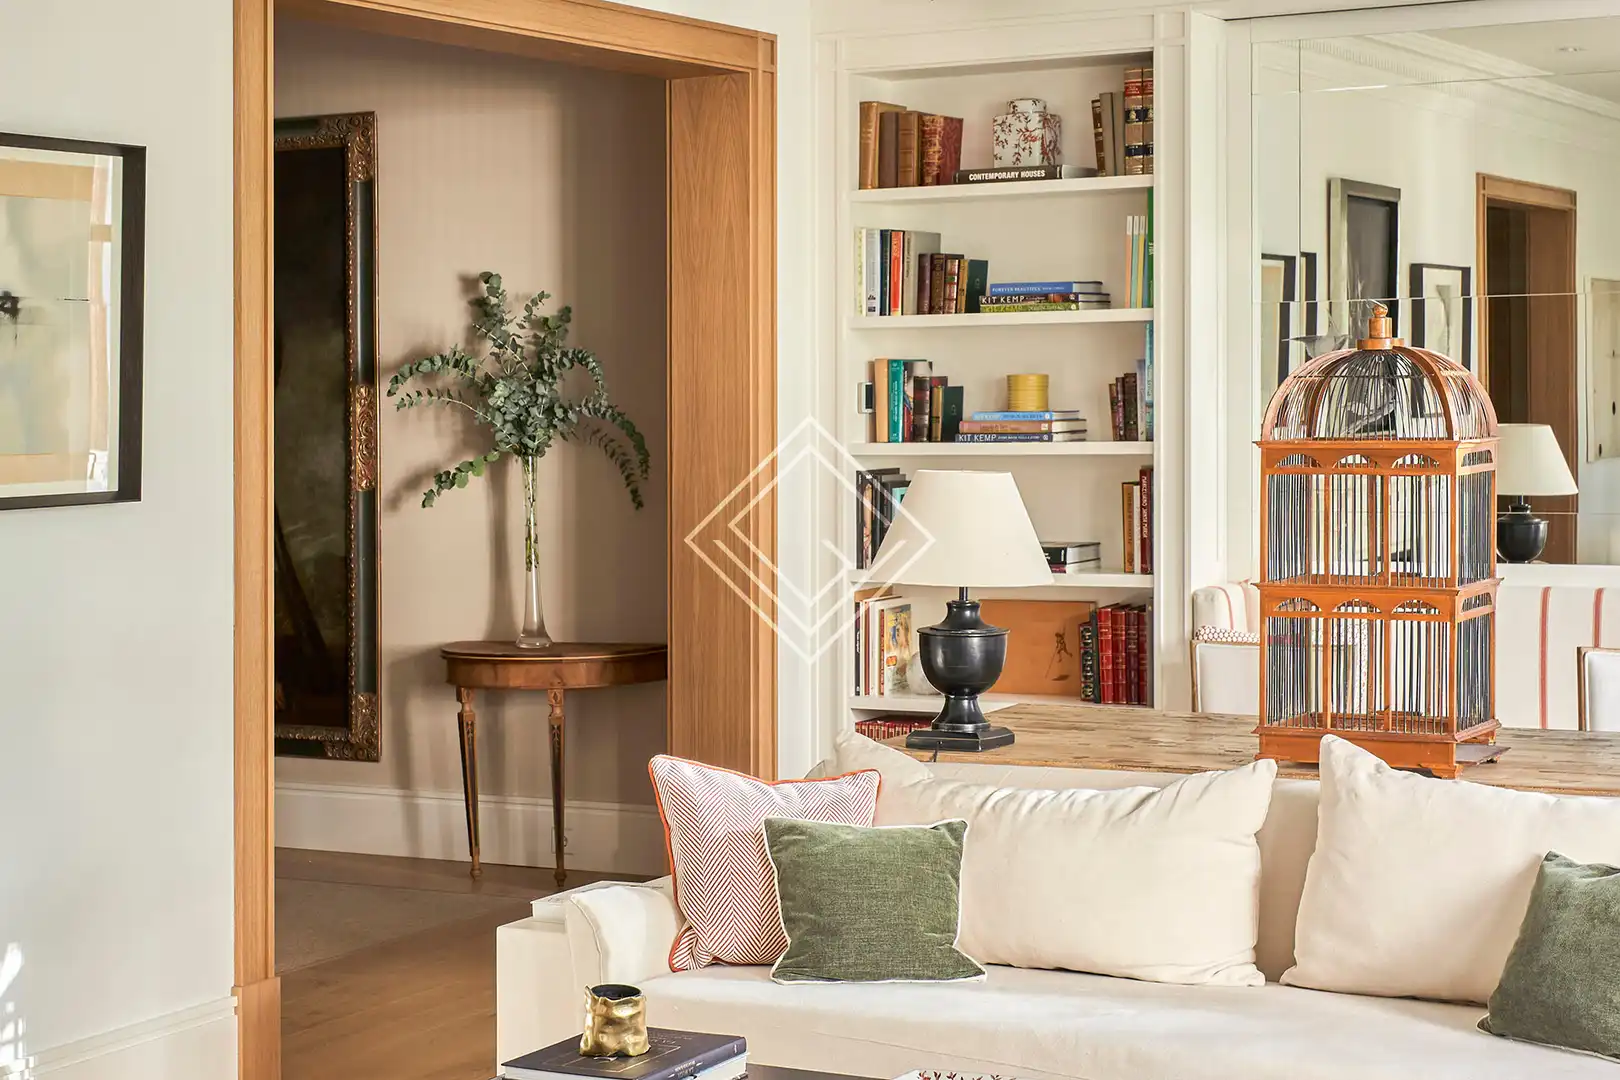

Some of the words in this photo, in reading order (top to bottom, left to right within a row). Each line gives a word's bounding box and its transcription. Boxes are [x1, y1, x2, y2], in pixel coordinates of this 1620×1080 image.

[969, 171, 1019, 181] CONTEMPORARY
[1020, 169, 1046, 178] HOUSES
[982, 296, 998, 304] KIT
[1000, 295, 1025, 303] KEMP
[974, 433, 996, 441] KEMP
